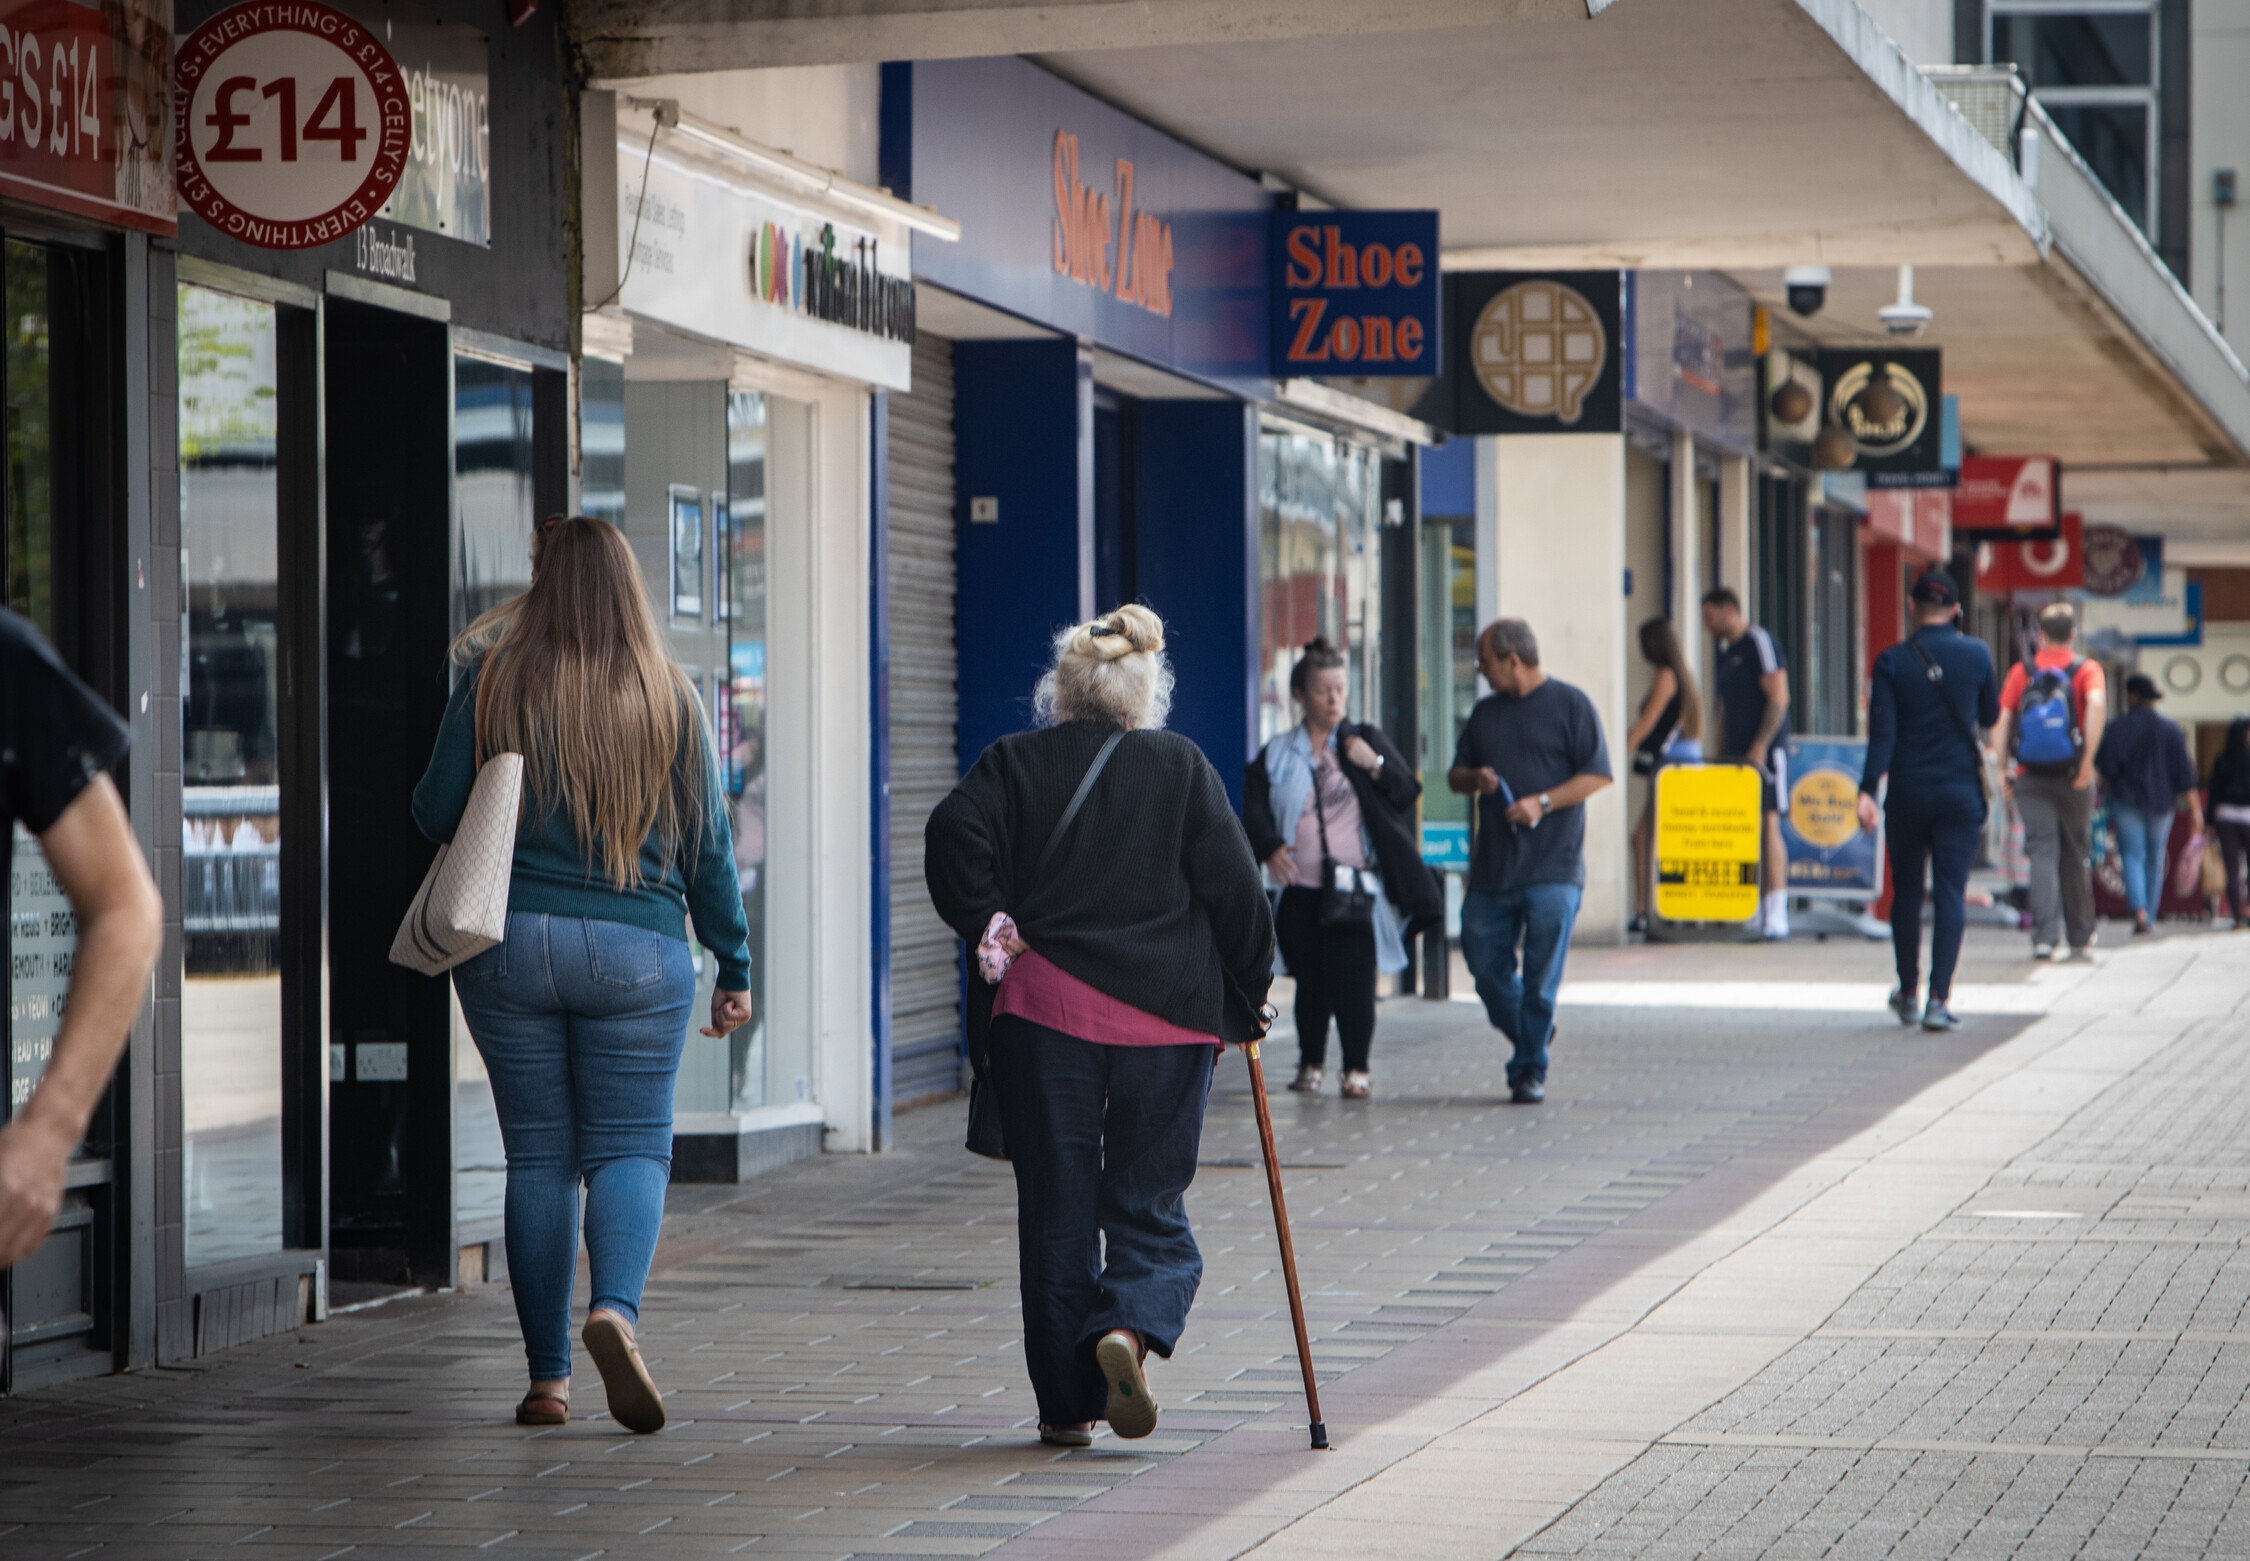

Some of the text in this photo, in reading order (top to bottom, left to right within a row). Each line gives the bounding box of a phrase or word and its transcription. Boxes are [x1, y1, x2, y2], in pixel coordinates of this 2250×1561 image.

[199, 5, 359, 56] EVERYTHING'S
[356, 43, 393, 85] £14
[50, 35, 100, 162] £14
[205, 75, 368, 163] £14
[177, 97, 405, 246] CELLY'S EVERYTHING'S £14
[356, 225, 416, 283] 13 Broadwalk
[1053, 128, 1111, 294] Shoe
[1115, 157, 1174, 319] Zone
[1285, 225, 1424, 289] Shoe
[1286, 298, 1424, 363] Zone
[20, 912, 40, 938] REGIS
[12, 1037, 32, 1063] TEAD
